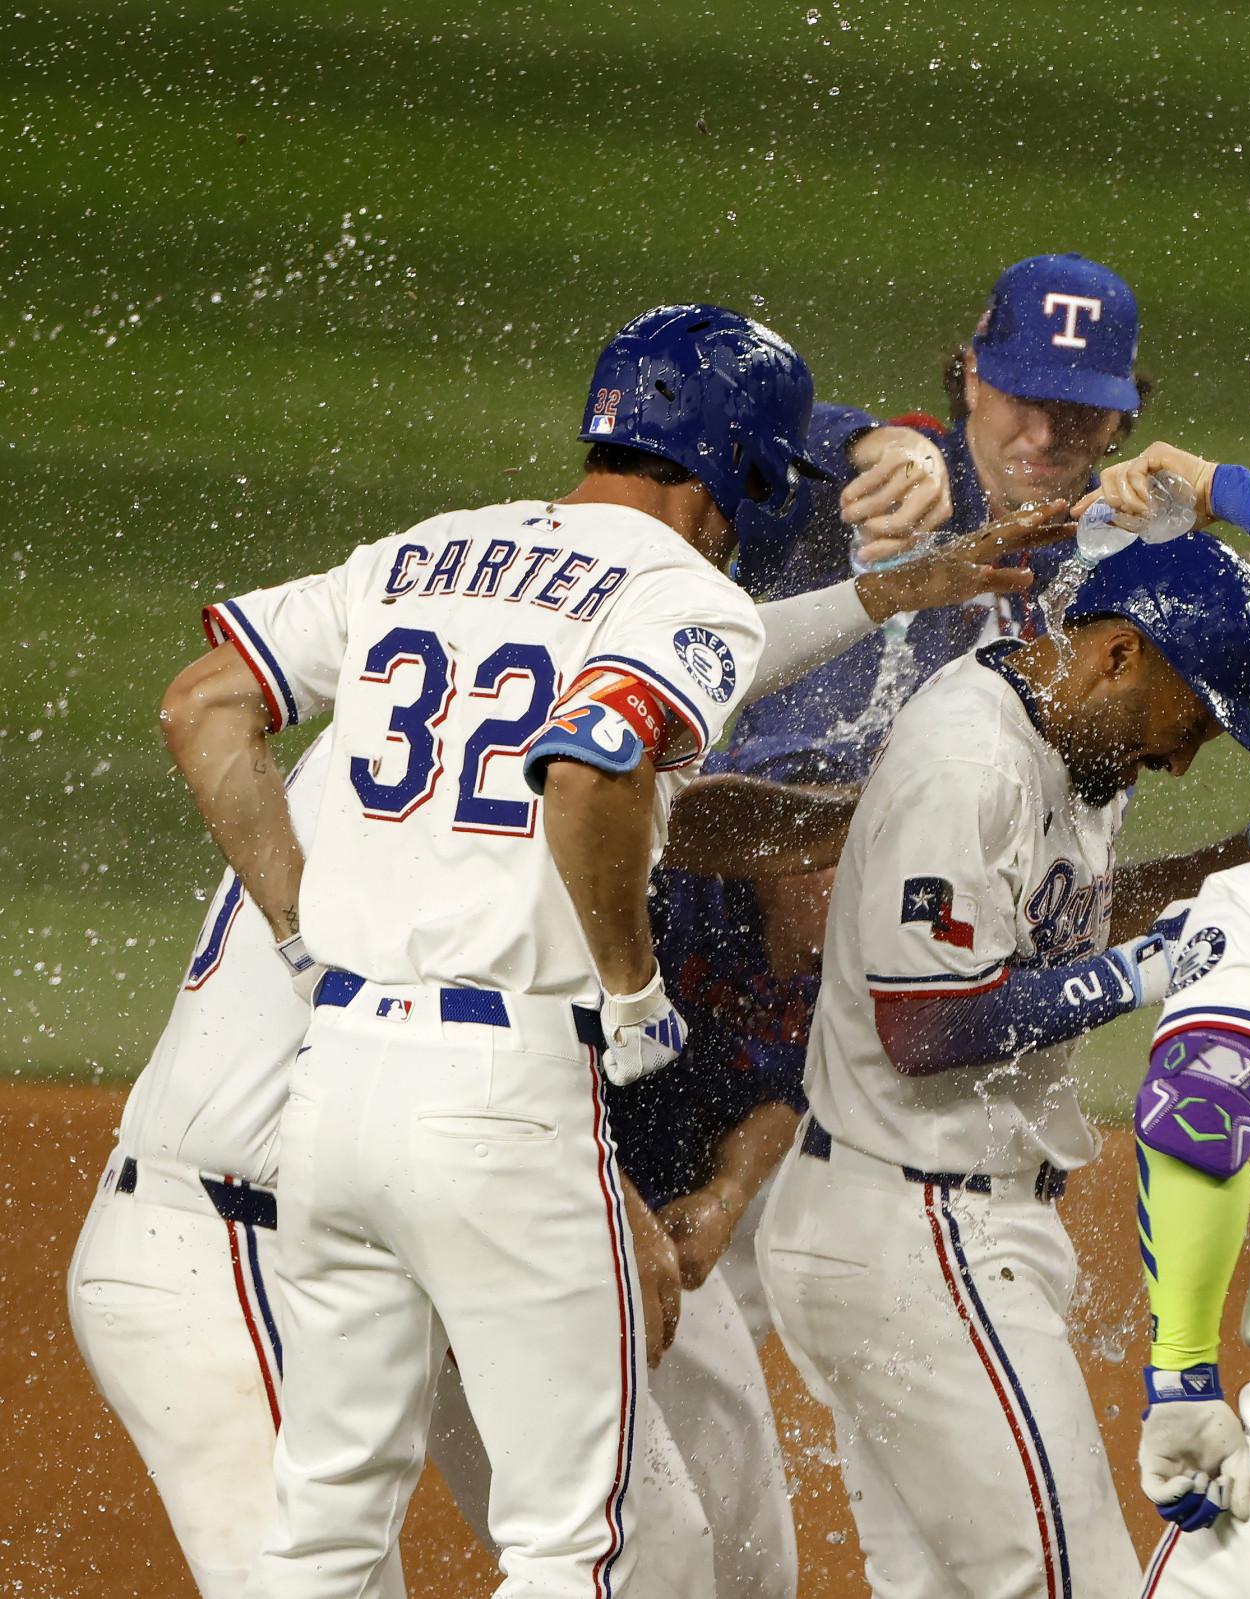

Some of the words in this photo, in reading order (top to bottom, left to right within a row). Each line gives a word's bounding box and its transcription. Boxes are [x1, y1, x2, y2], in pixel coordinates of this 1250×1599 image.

[1044, 291, 1102, 350] T
[593, 387, 621, 416] 32
[383, 537, 630, 622] CARTER
[684, 628, 735, 687] ENERGY
[350, 626, 563, 839] 32
[626, 694, 660, 741] abso
[1063, 970, 1105, 1007] 2
